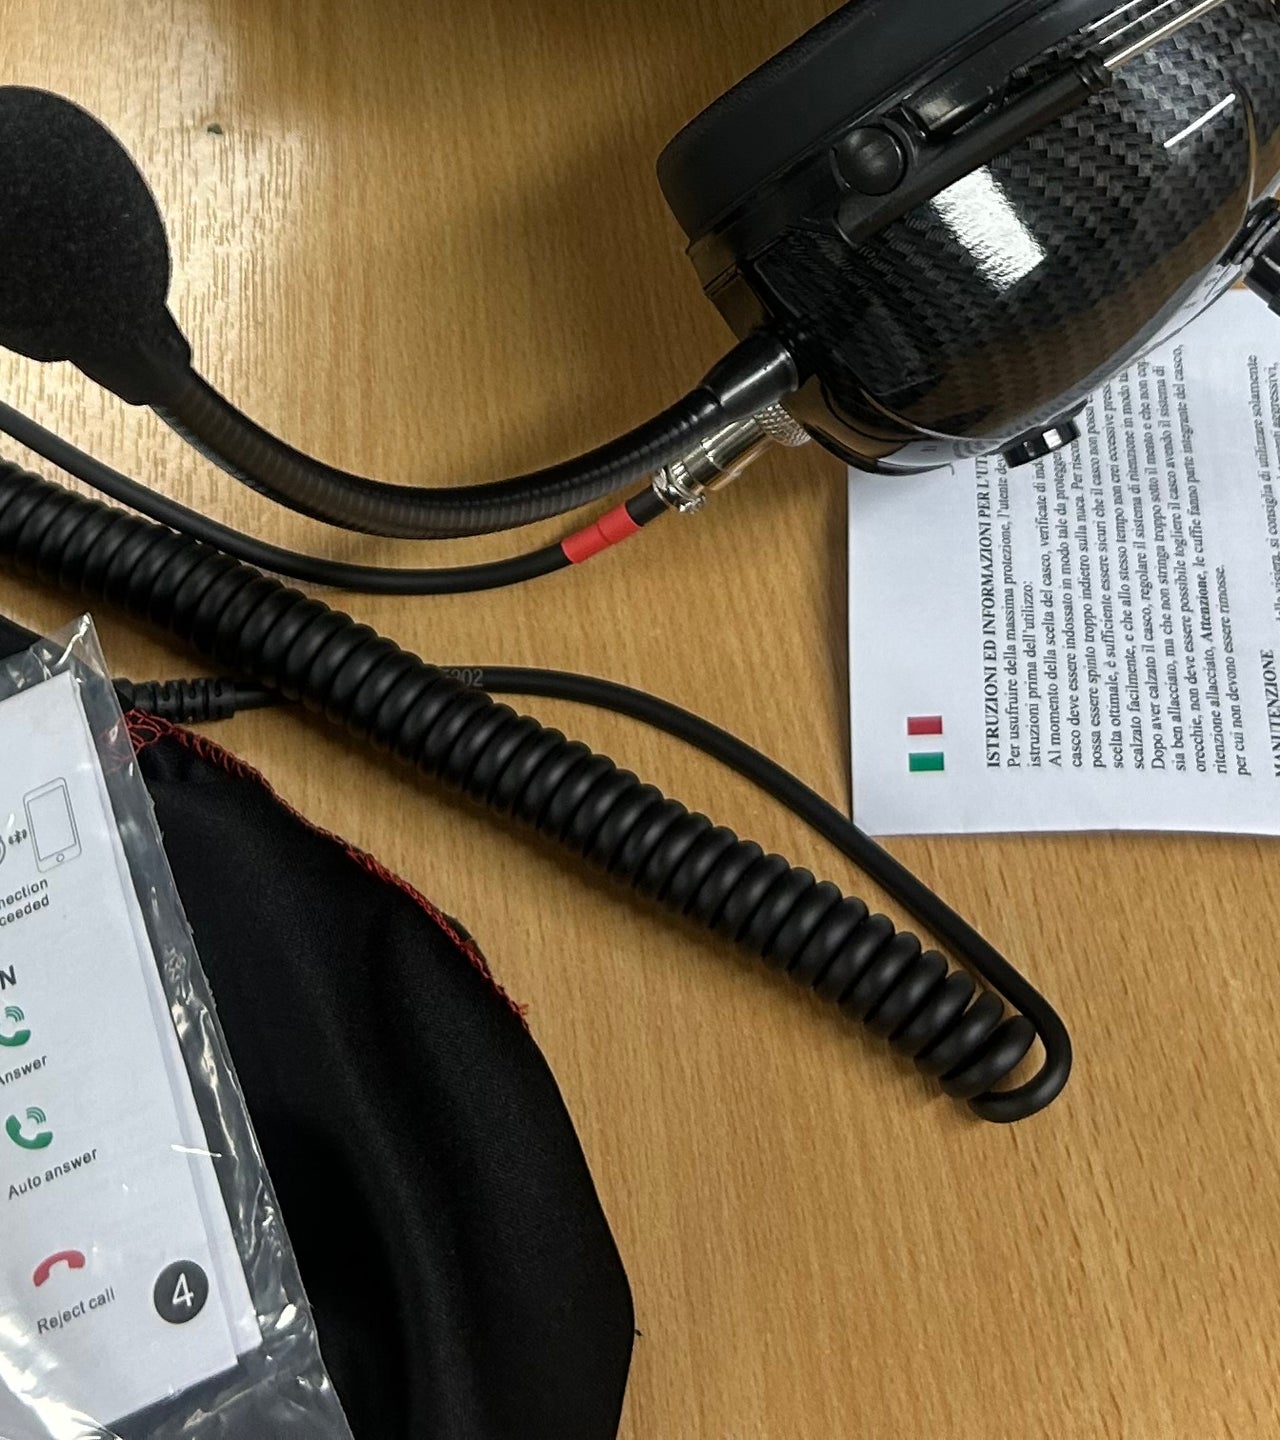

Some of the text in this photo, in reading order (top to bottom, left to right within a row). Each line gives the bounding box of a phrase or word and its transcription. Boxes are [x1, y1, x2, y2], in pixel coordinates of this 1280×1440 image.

[997, 477, 1010, 519] l'utente
[1034, 482, 1046, 493] di
[1071, 473, 1083, 491] Per
[977, 492, 990, 519] PER
[1036, 495, 1050, 547] verificate
[1075, 492, 1086, 522] nuca.
[1000, 520, 1016, 585] protezione,
[1075, 525, 1089, 553] sulla
[978, 522, 996, 636] INFORMAZIONI
[1041, 550, 1052, 587] casco,
[1078, 554, 1092, 601] indietro
[1003, 587, 1016, 642] massima
[1040, 589, 1054, 609] del
[1042, 611, 1056, 646] scelta
[1054, 502, 1082, 768] casco deve essere indossato in modo tale da
[1083, 603, 1098, 643] troppo
[983, 639, 997, 662] ED
[1004, 644, 1018, 676] della
[1043, 649, 1058, 681] della
[1084, 646, 1101, 685] spinto
[1215, 564, 1252, 776] per cui non devono essere rimosse.
[1022, 581, 1041, 768] istruzioni prima dell'utilizzo:
[984, 666, 1000, 768] ISTRUZIONI
[1006, 679, 1020, 740] usufruire
[1046, 683, 1061, 747] momento
[1089, 686, 1101, 727] essere
[1008, 745, 1021, 768] Per
[1048, 750, 1062, 767] Al
[1091, 730, 1107, 768] possa
[8, 1148, 98, 1201] Auto answer
[172, 1272, 195, 1308] 4
[37, 1286, 116, 1335] Reject call
